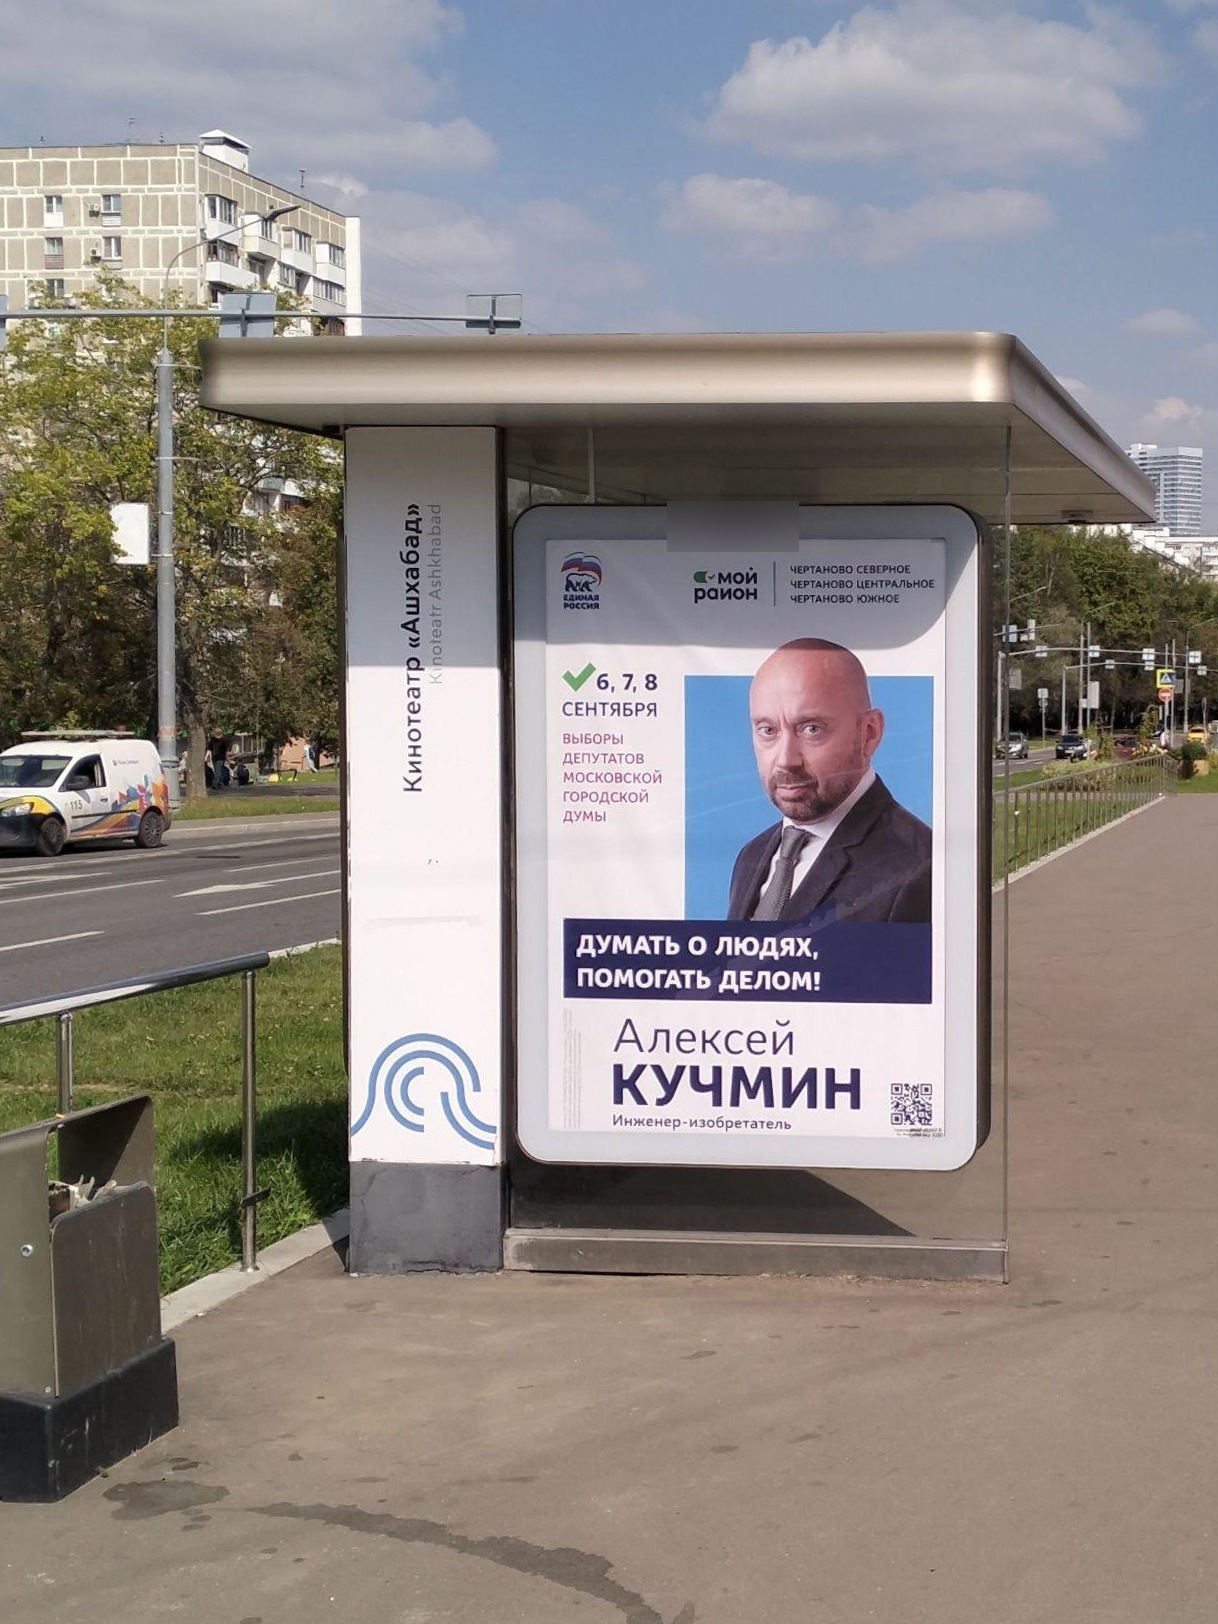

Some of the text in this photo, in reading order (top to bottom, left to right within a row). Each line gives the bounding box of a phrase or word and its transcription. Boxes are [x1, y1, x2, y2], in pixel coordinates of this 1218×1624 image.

[718, 566, 758, 585] мой
[790, 564, 911, 575] ЧЕРТАНОВО СЕВЕРНОЕ
[790, 579, 935, 590] ЧЕРТАНОВО ЦЕНТРАЛЬНОЕ
[427, 504, 443, 684] Kinoteatr Ashkhabad
[563, 594, 600, 602] ЕДИНАЯ
[790, 593, 900, 604] ЧЕРТАНОВО ЮЖНОЕ
[563, 602, 600, 610] РОССИЯ
[400, 502, 425, 792] Кинотеатр «Ашхабад»
[596, 673, 658, 693] 6, 7, 8
[562, 701, 658, 717] СЕНТЯБРЯ
[562, 733, 624, 745] ВЫБОРЫ
[562, 752, 645, 766] ДЕПУТАТОВ
[563, 769, 663, 784] МОСКОВСКОЙ
[563, 788, 649, 805] ГОРОДСКОЙ
[562, 811, 607, 824] ДУМЫ
[576, 934, 820, 961] ДУМАТЬ О ЛЮДЯХ,
[576, 968, 821, 995] ПОМОГАТЬ ДЕЛОМ!
[613, 1018, 794, 1056] Алексей
[612, 1063, 861, 1110] КУЧМИН
[612, 1114, 792, 1132] Инженер-изобретатель
